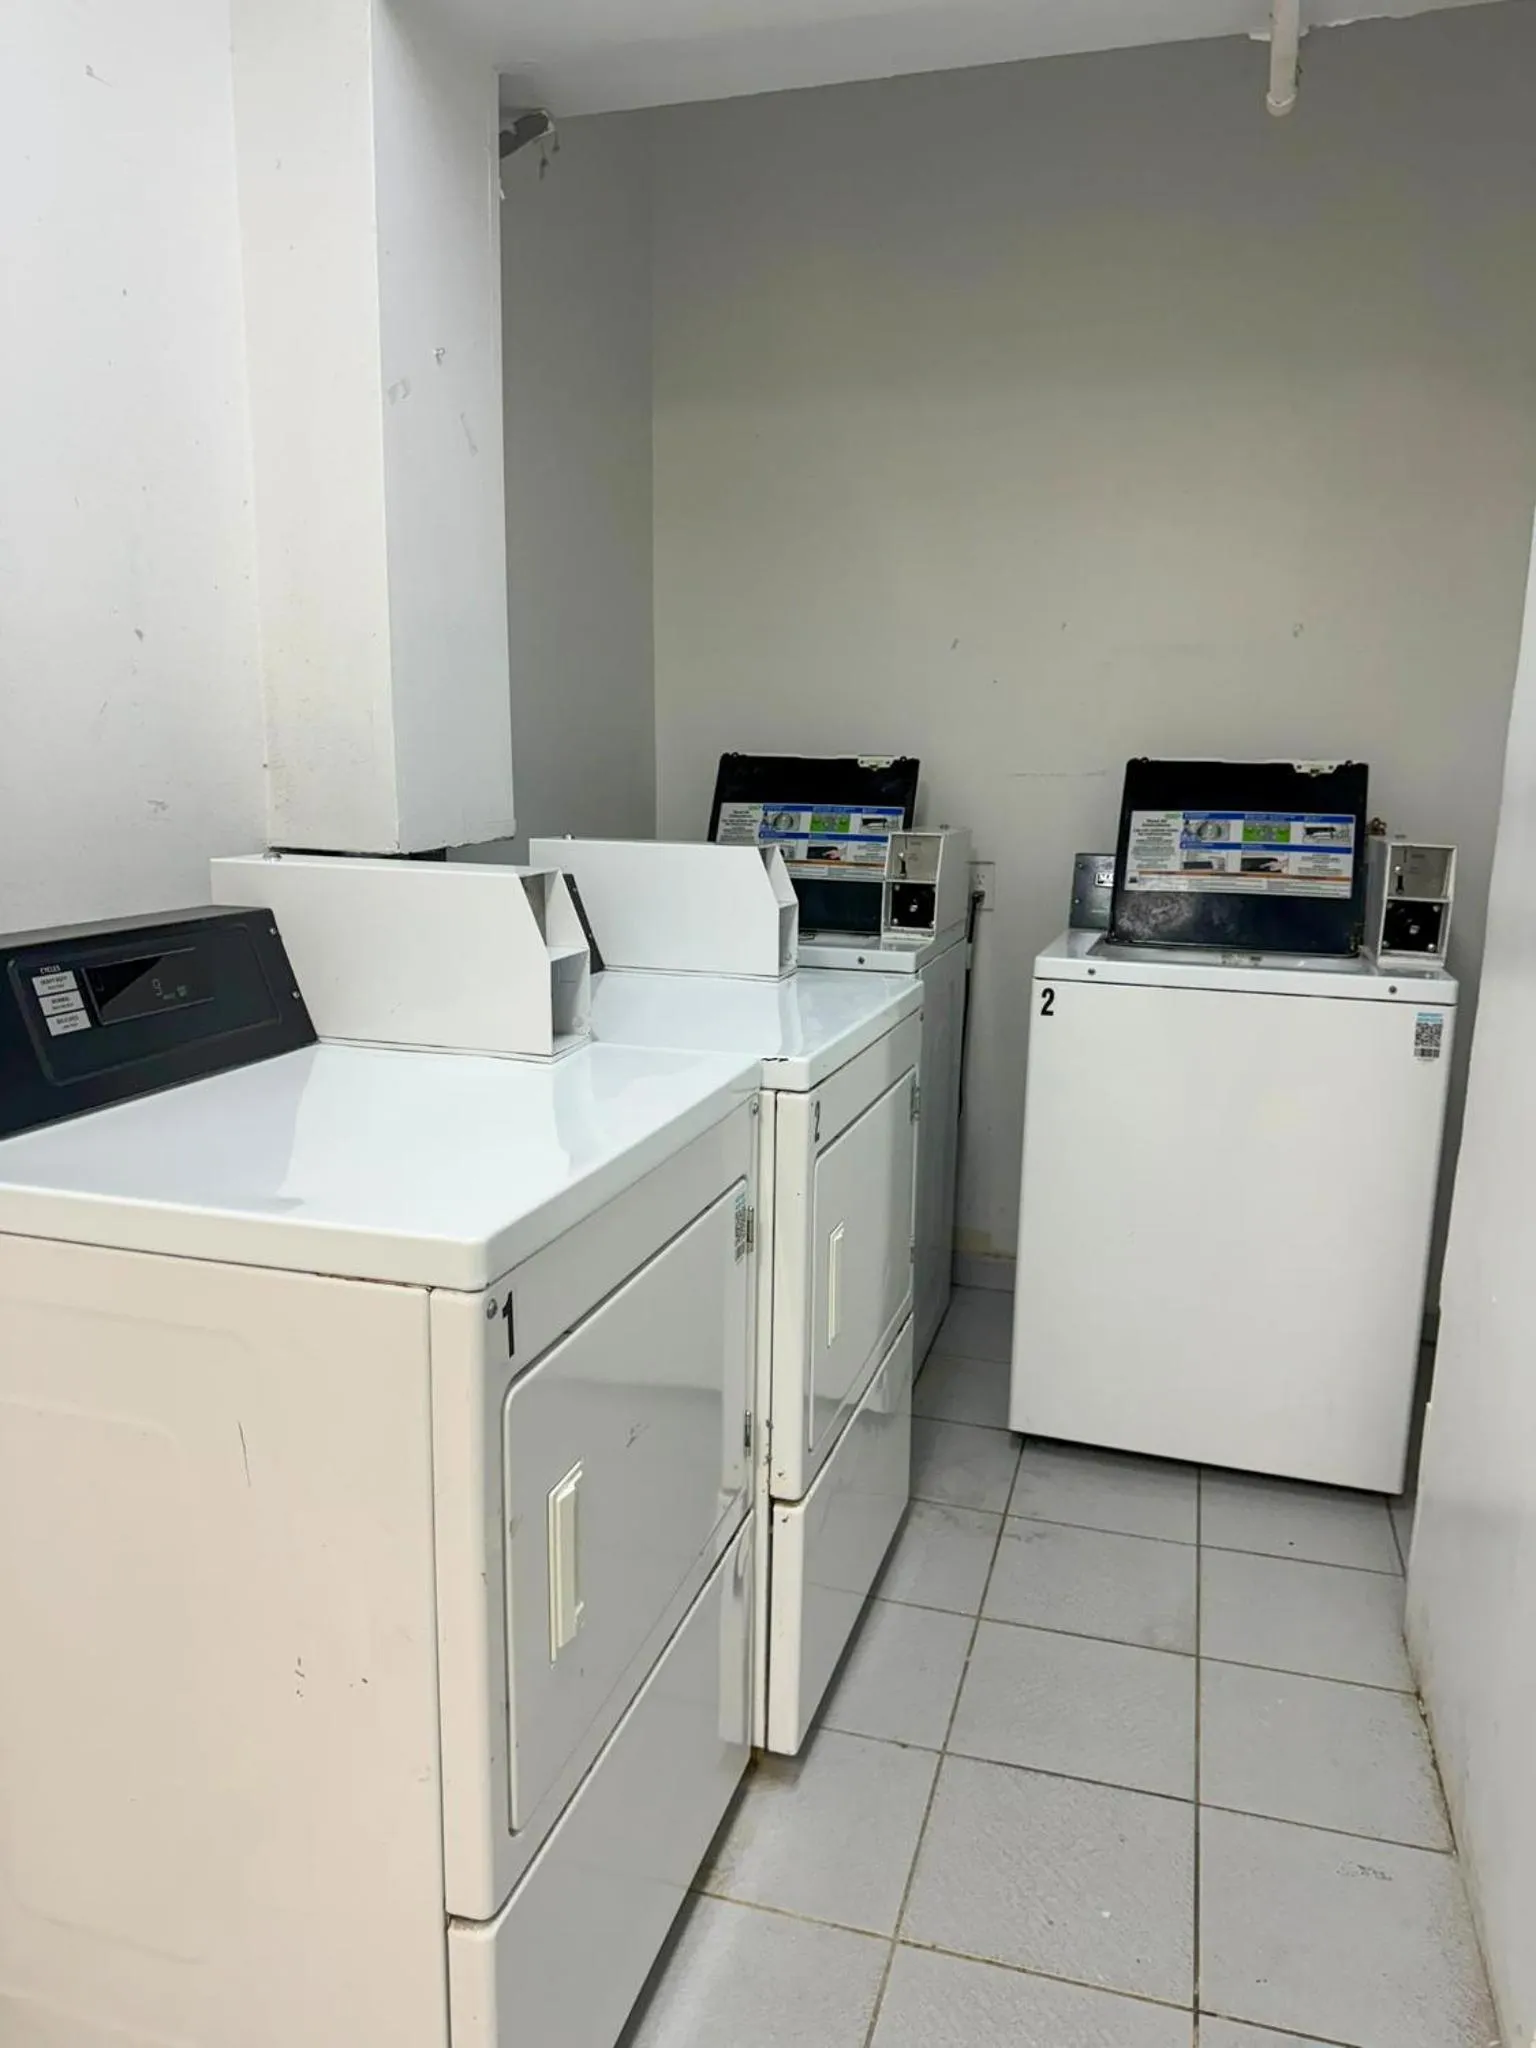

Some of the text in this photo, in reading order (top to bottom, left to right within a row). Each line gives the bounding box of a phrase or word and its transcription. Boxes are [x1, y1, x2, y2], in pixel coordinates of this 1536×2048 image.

[1040, 987, 1055, 1016] 2
[814, 1100, 821, 1143] 2
[502, 1290, 515, 1358] 1
